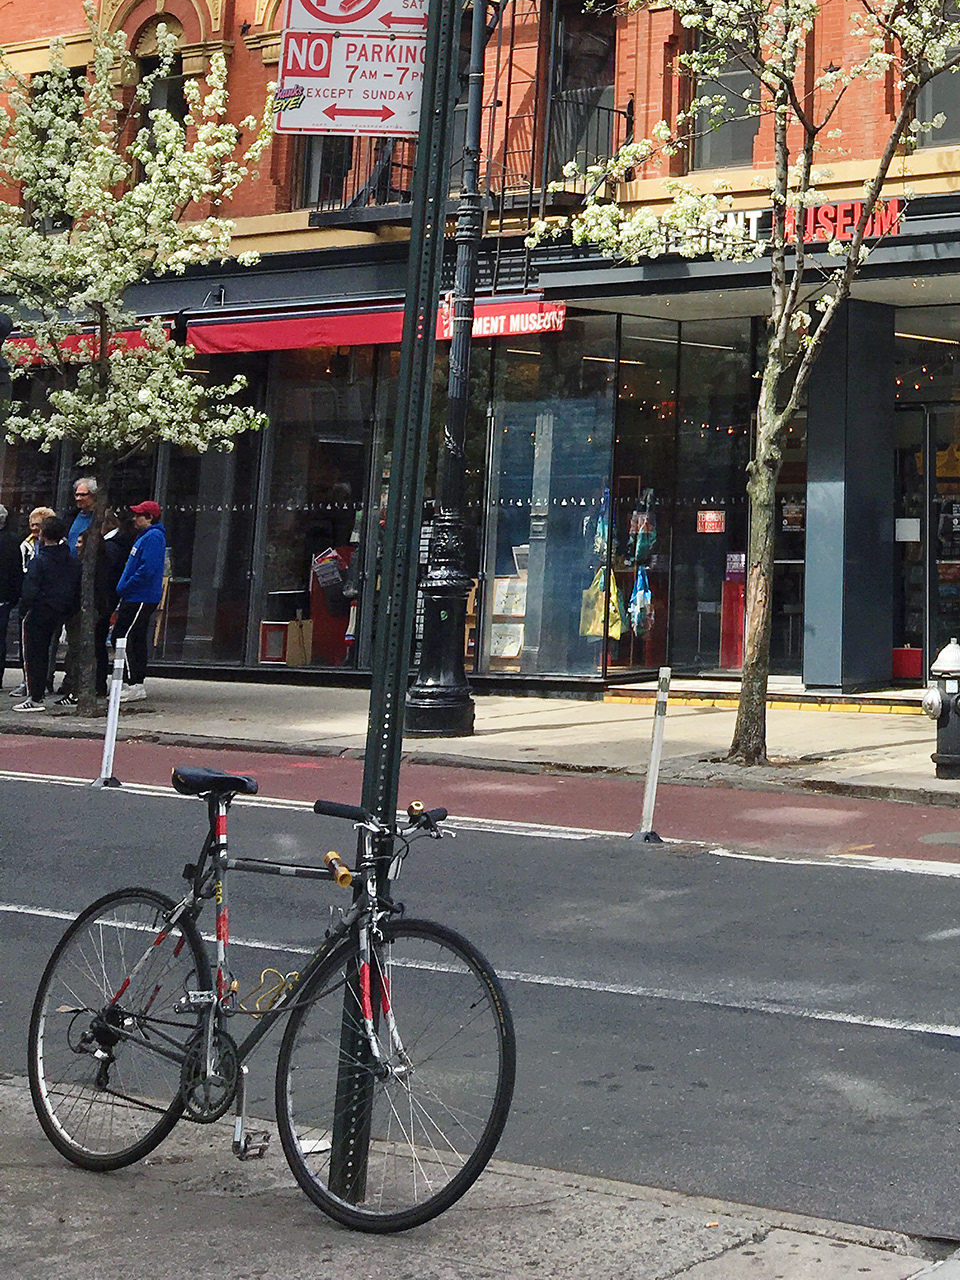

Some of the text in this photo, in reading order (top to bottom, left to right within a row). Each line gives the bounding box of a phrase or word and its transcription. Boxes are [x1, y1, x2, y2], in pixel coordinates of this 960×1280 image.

[402, 0, 425, 9] SAT
[286, 38, 329, 71] NO
[306, 87, 414, 101] EXCEPT SUNDAY
[272, 96, 306, 113] BYE!
[509, 310, 564, 332] MUSEUM
